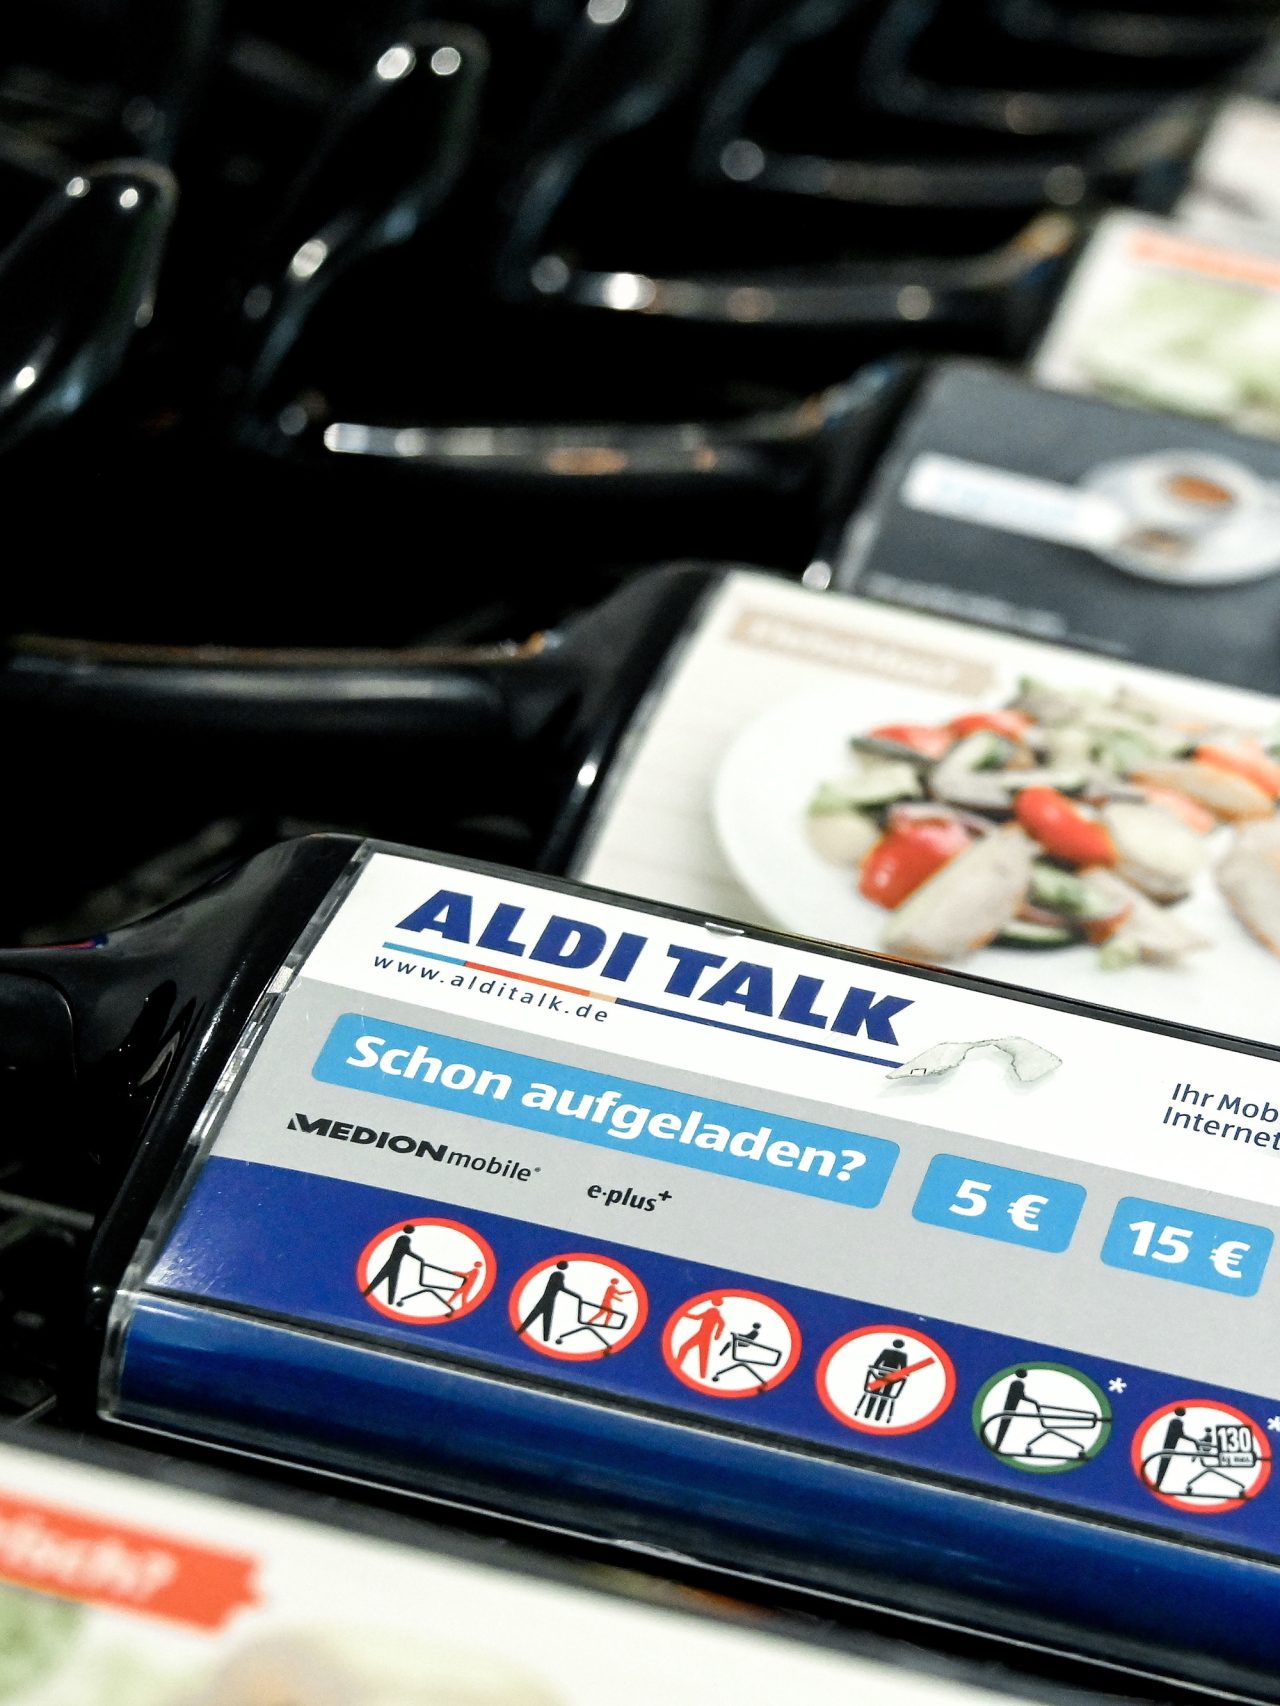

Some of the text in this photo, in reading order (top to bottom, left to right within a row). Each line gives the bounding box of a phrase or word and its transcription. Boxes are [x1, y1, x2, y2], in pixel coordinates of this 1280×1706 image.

[373, 953, 609, 1023] www.alditalk.de
[395, 889, 917, 1046] ALDI TALK
[345, 1033, 867, 1184] Schon aufgeladen?
[1171, 1083, 1214, 1107] Ihr
[947, 1178, 1050, 1232] 5 €
[1127, 1219, 1251, 1280] 15 €
[1218, 1427, 1252, 1452] 130
